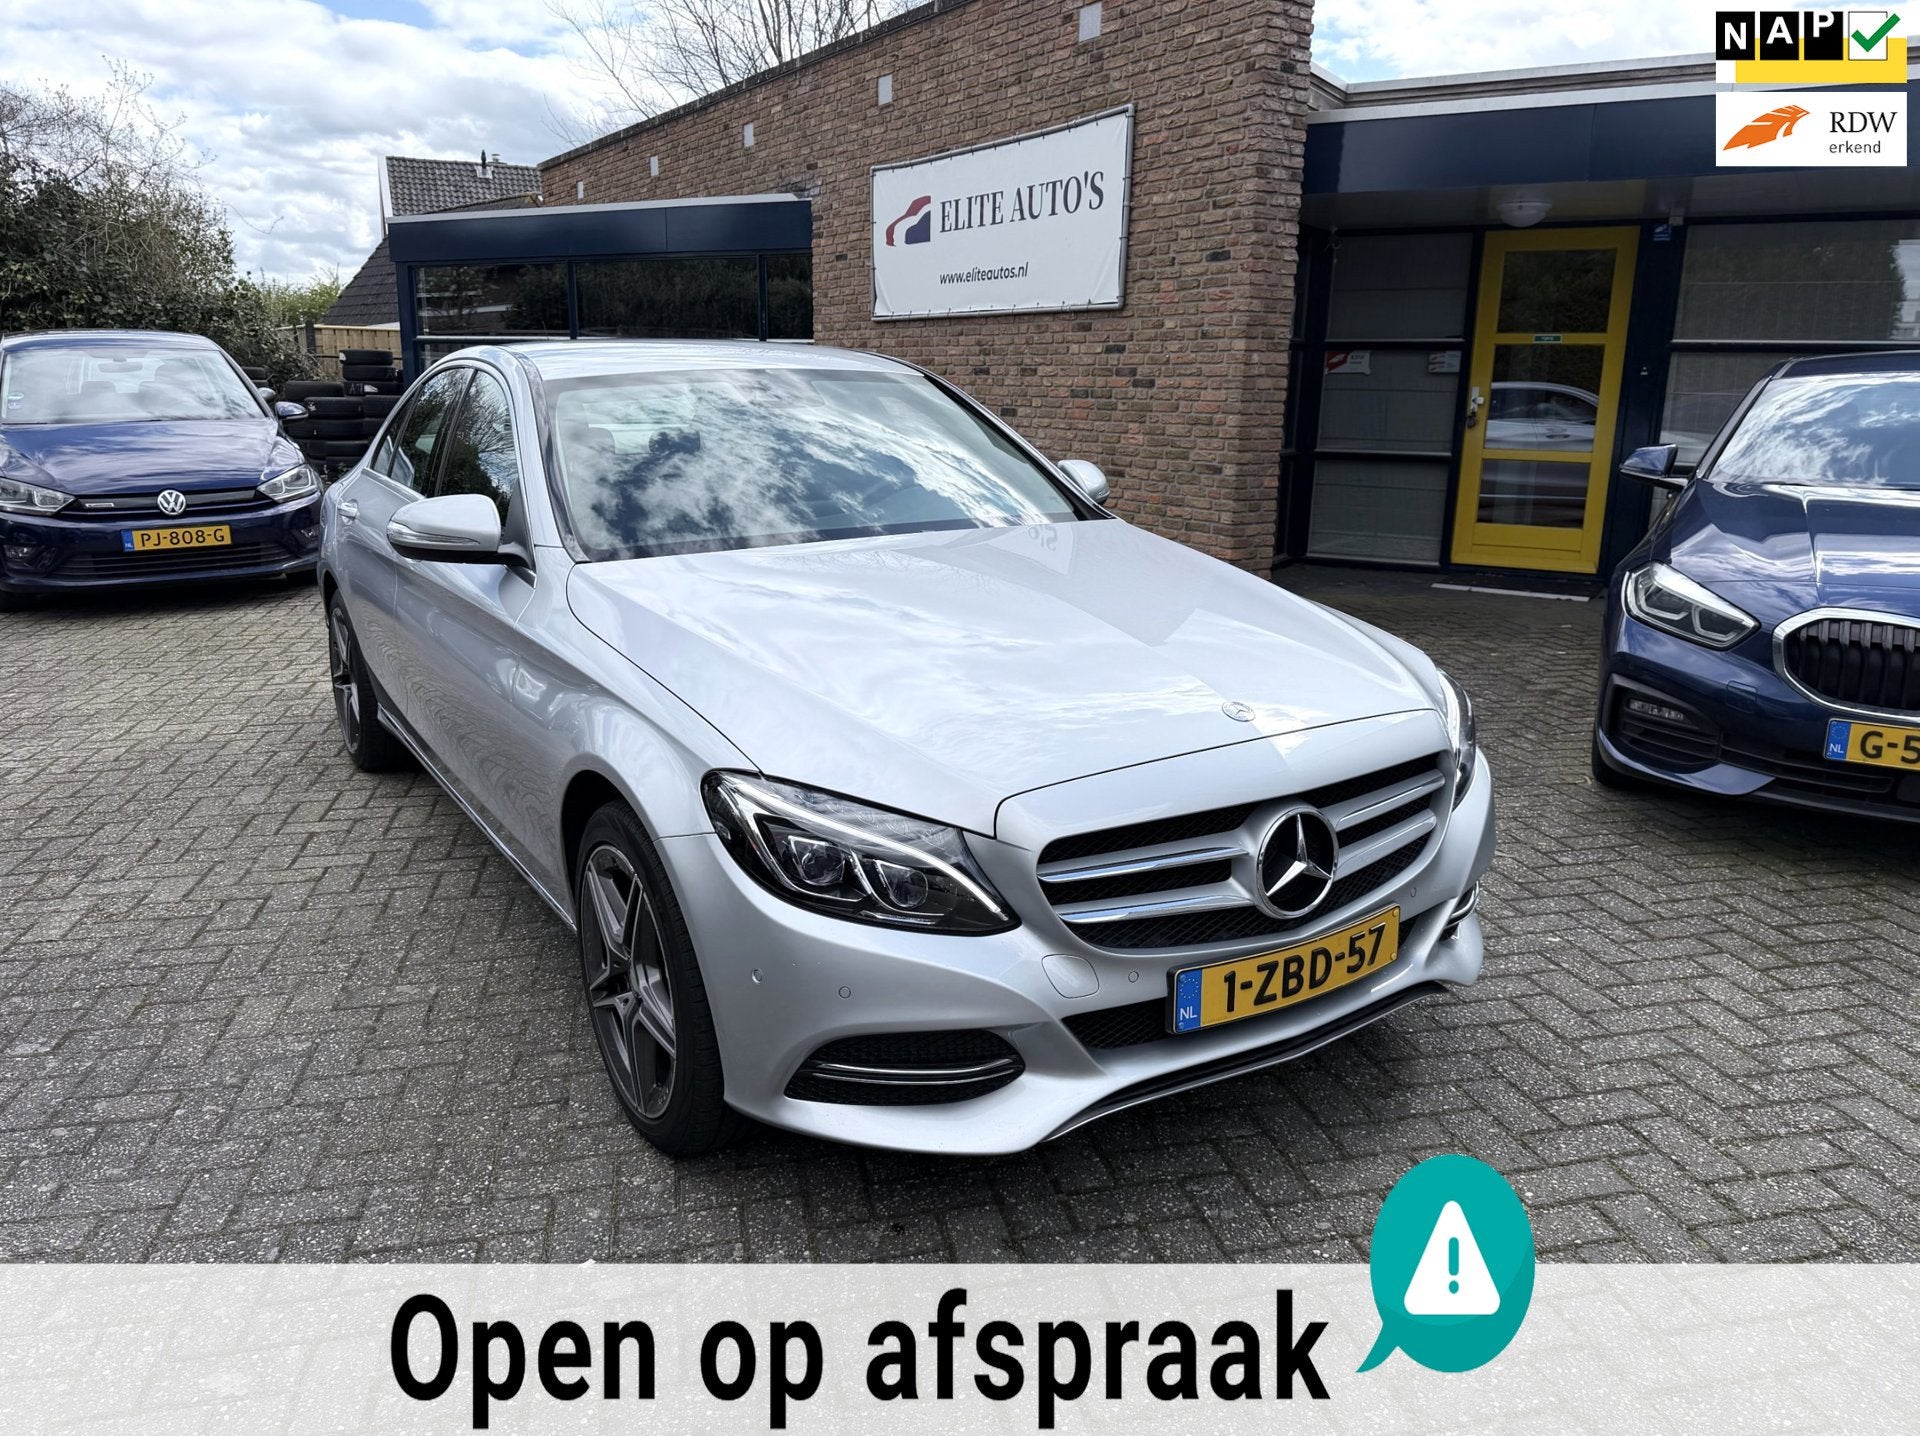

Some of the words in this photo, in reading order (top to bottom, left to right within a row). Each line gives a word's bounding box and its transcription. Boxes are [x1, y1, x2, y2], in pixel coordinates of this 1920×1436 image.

[940, 190, 1004, 233] ELITE
[1010, 171, 1104, 222] AUTO'S
[940, 262, 1028, 284] www.eliteautos.nl
[140, 529, 225, 547] PJ-808-G
[1829, 743, 1844, 753] NL
[1860, 730, 1920, 764] G-5
[1180, 1006, 1197, 1020] NL
[1224, 922, 1386, 1012] 1-ZBD-57
